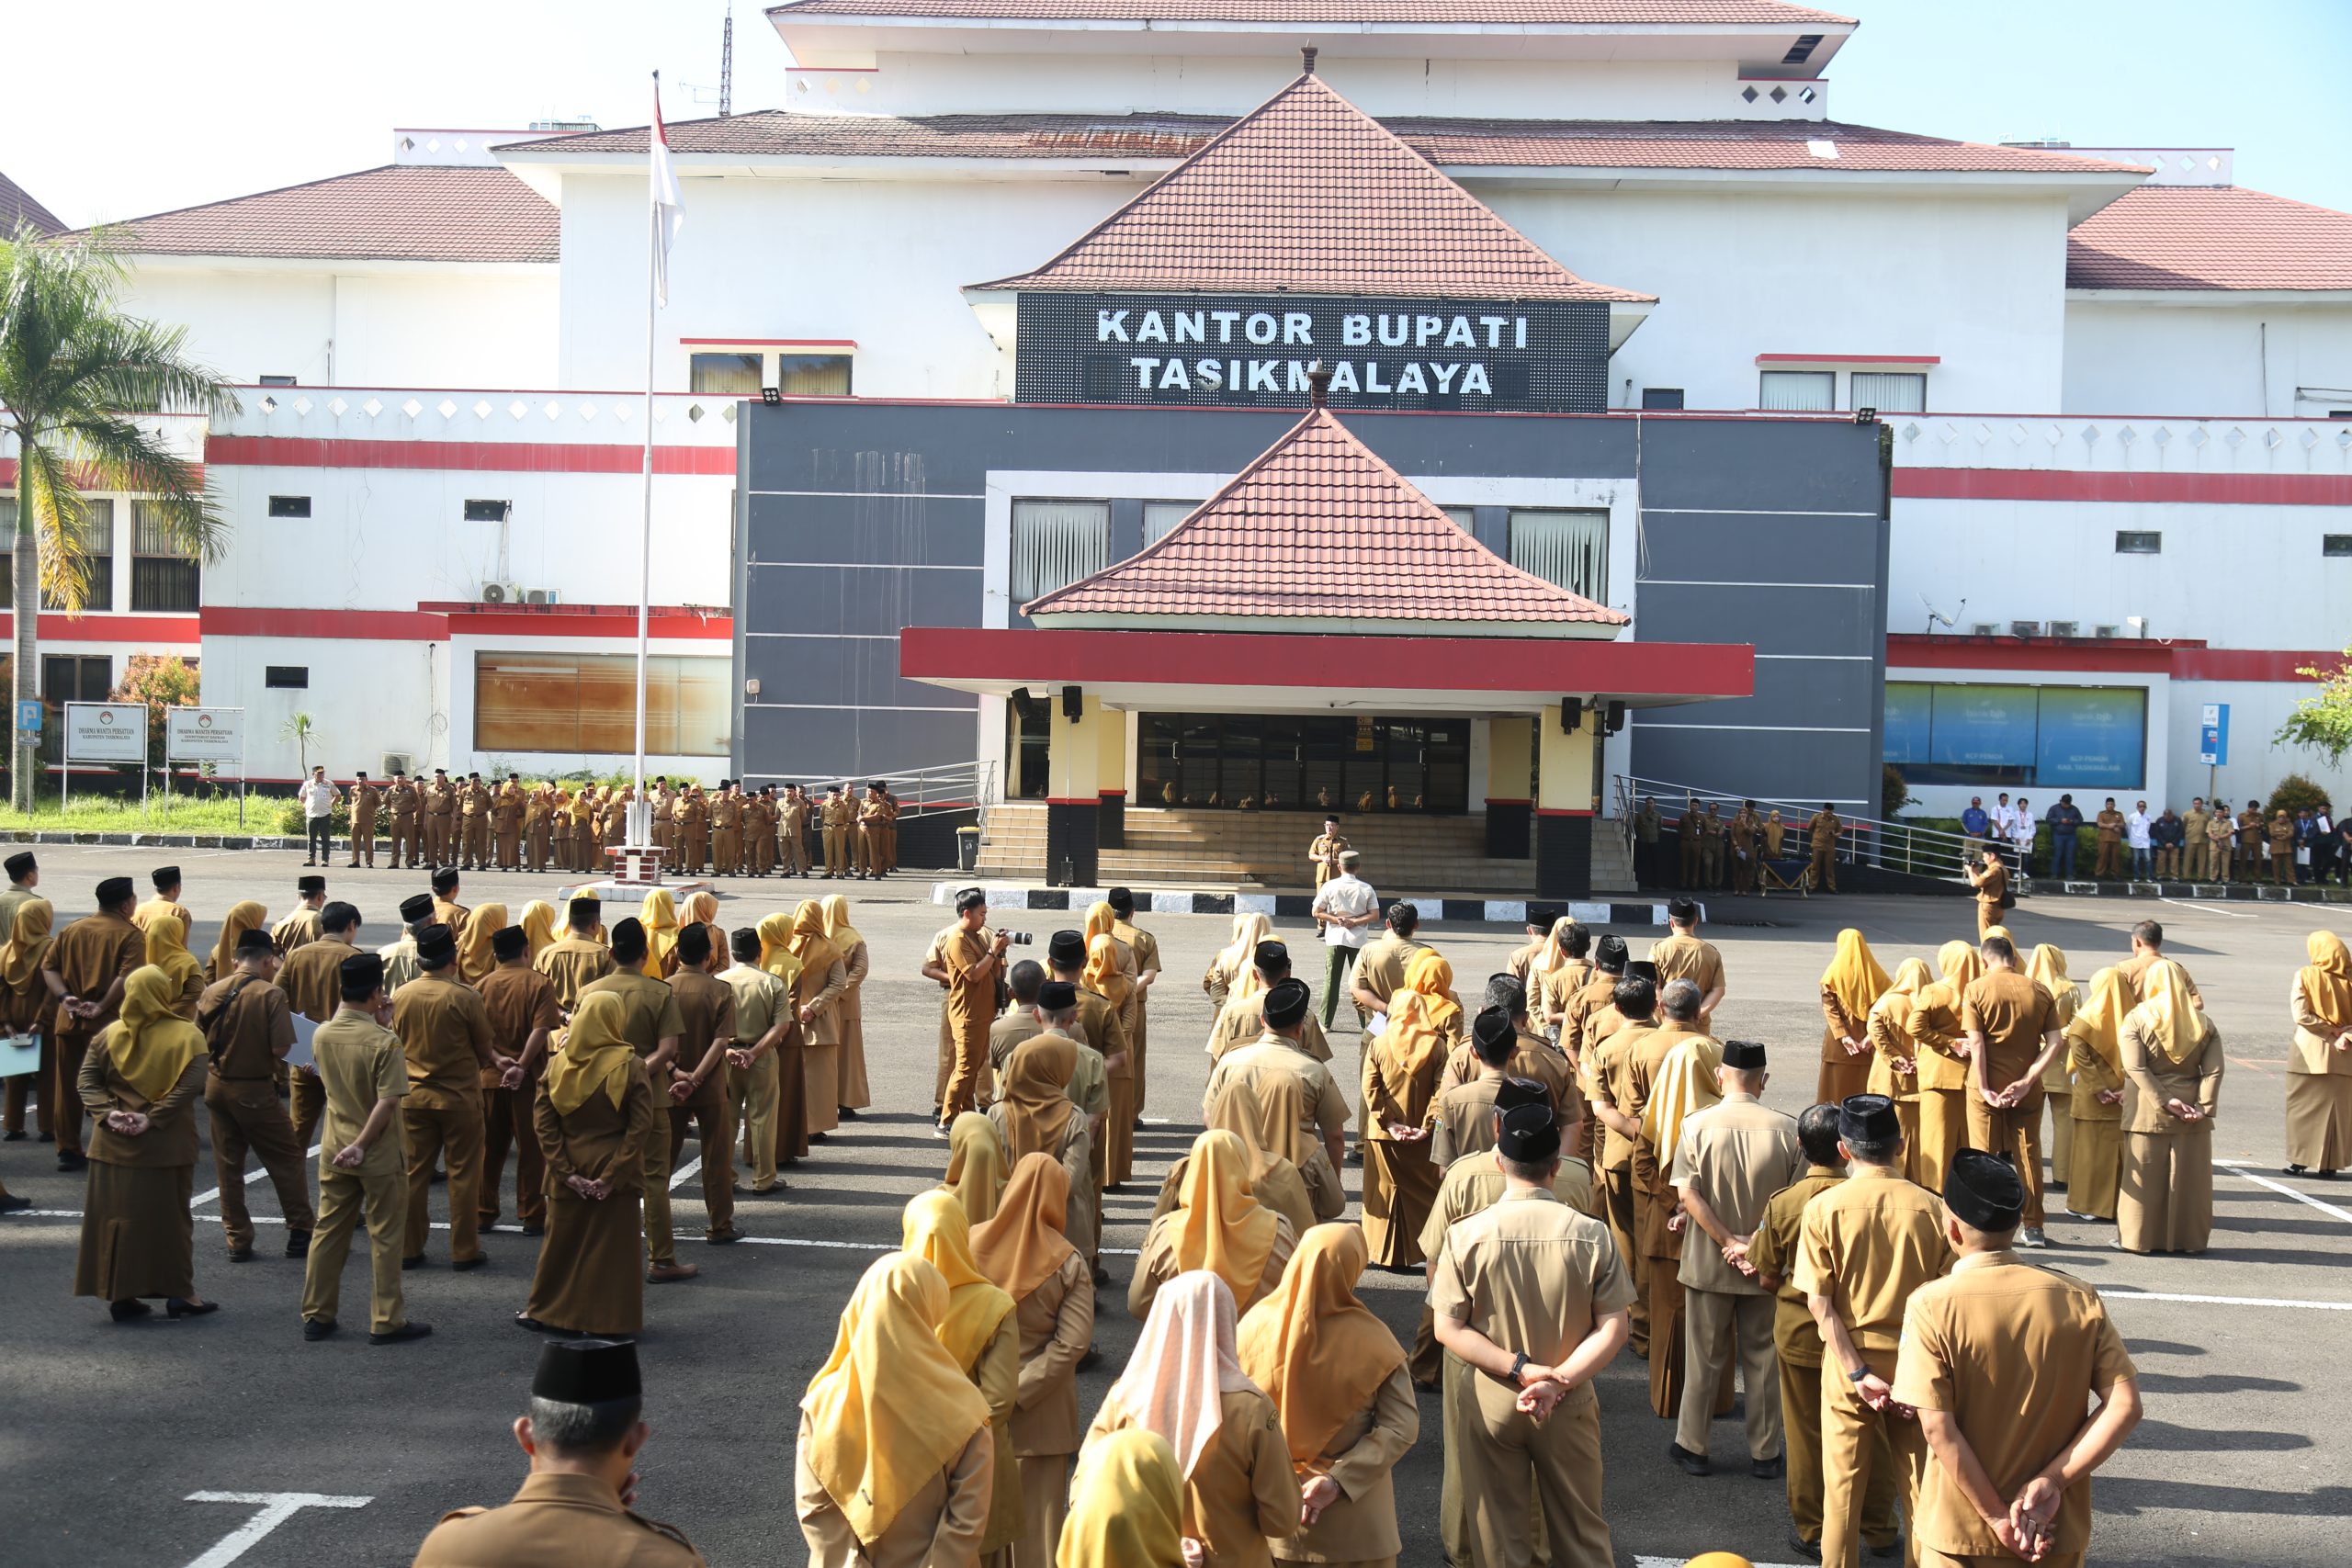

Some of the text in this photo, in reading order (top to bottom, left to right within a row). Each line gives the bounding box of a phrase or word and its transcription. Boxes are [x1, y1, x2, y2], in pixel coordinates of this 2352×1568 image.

[1097, 310, 1528, 349] KANTOR BUPATI
[1130, 357, 1493, 395] TASIKMALAYA
[23, 705, 37, 726] P
